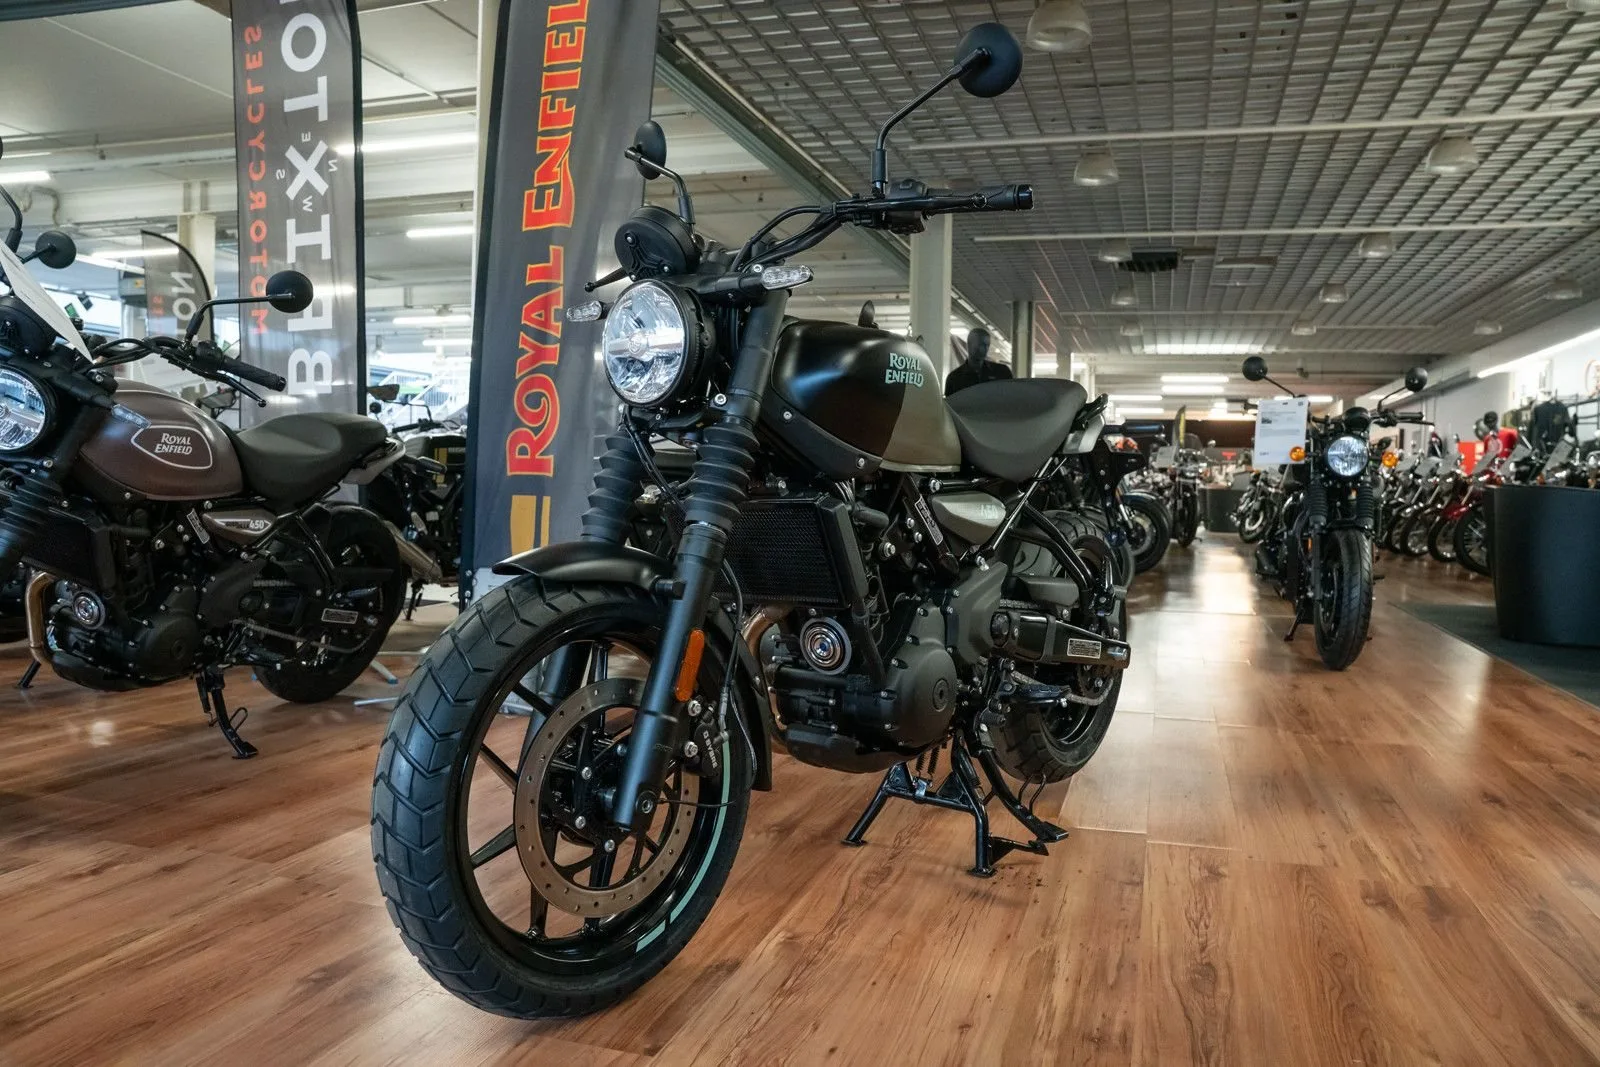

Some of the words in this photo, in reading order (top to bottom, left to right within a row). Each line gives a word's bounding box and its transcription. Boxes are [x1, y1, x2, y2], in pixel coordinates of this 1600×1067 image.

[506, 245, 564, 477] ROYAL
[889, 352, 922, 370] ROYAL
[885, 368, 924, 388] ENFIELD
[161, 432, 191, 445] ROYAL
[155, 443, 192, 455] ENFIELD
[248, 520, 265, 530] 450
